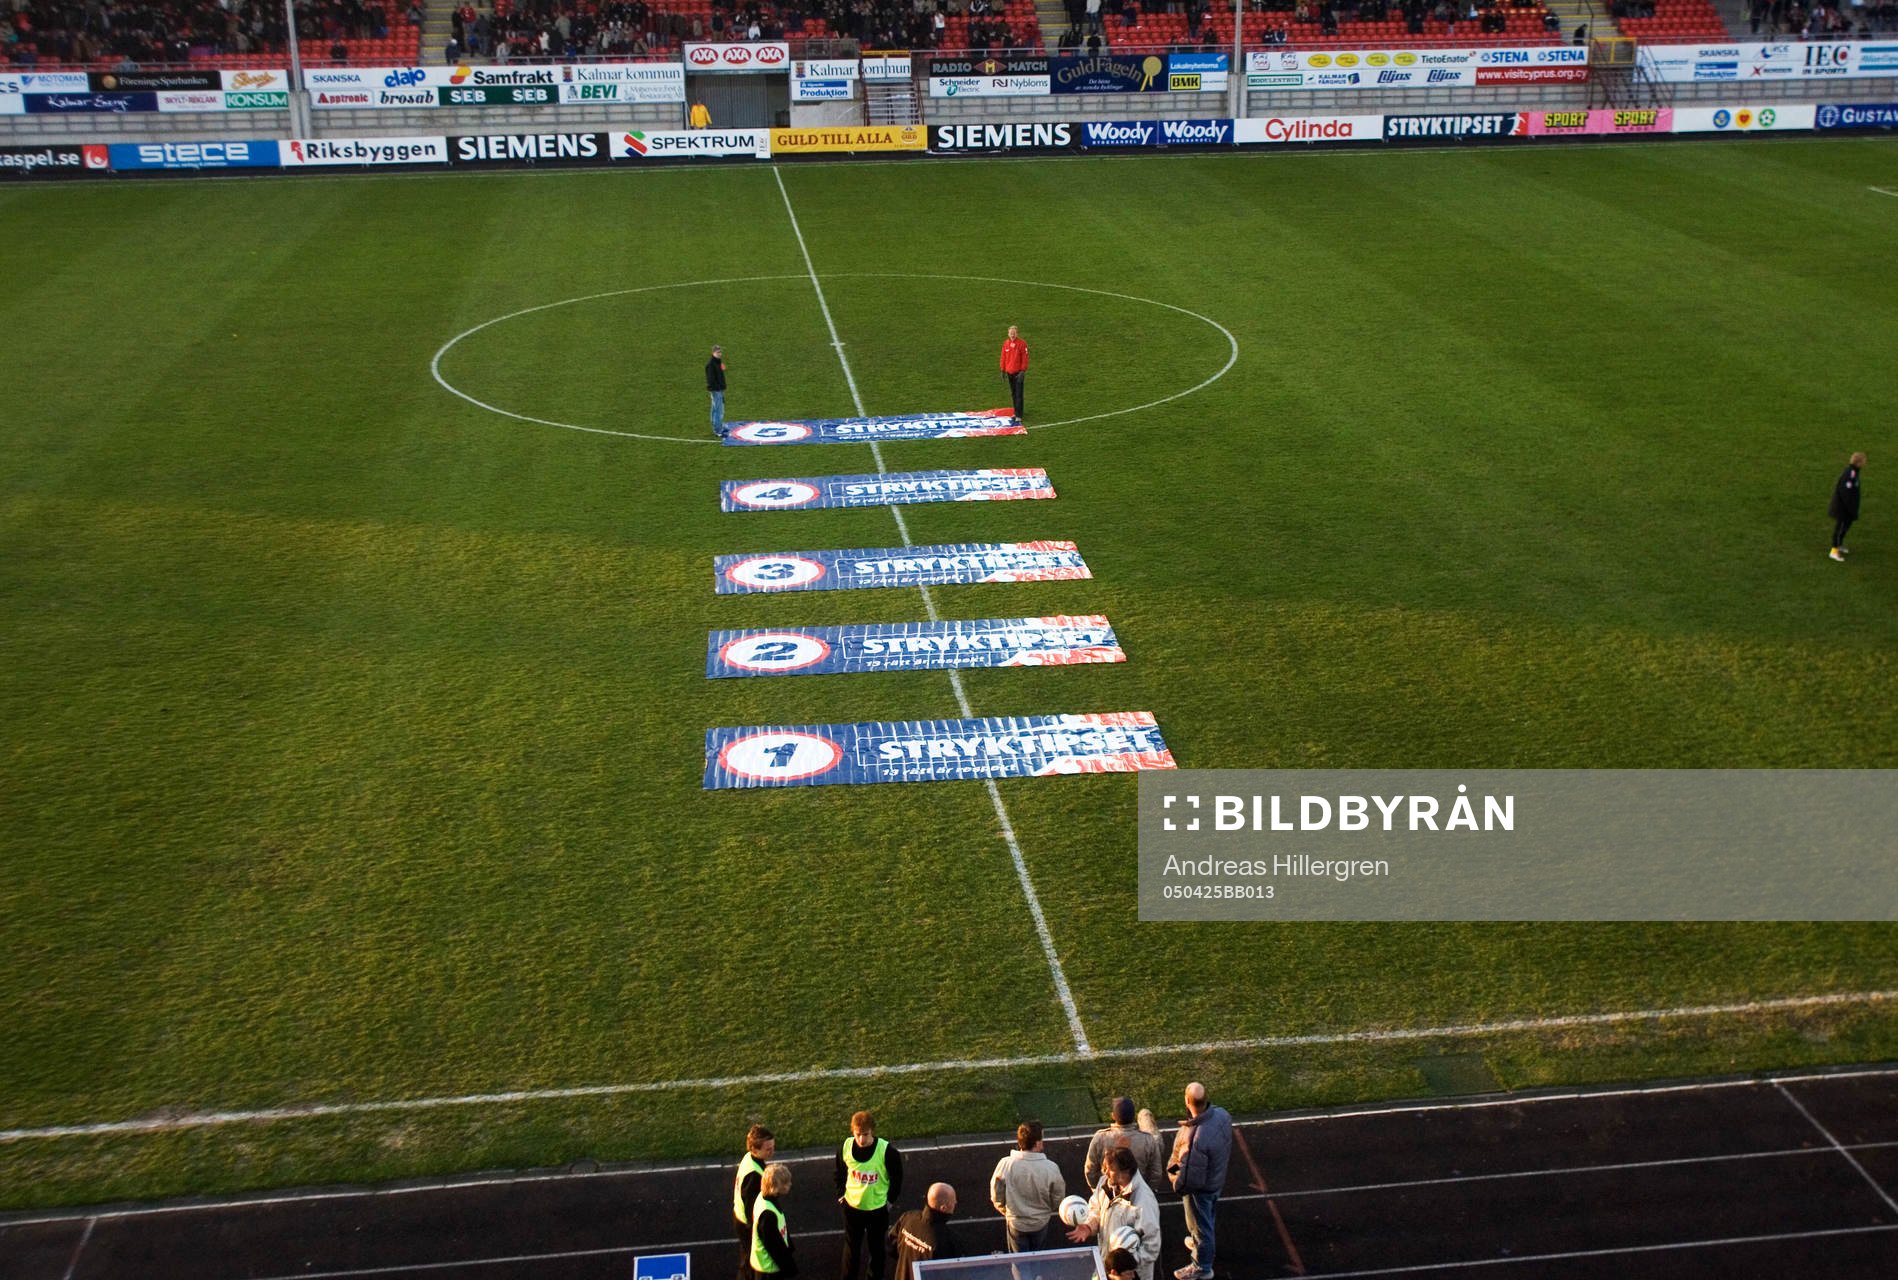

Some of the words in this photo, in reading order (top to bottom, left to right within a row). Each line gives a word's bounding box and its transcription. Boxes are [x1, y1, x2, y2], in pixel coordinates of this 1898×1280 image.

[692, 49, 717, 60] AXA
[725, 49, 749, 60] AXA
[759, 48, 783, 60] AXA
[1421, 54, 1470, 64] TietoEnator
[1491, 51, 1529, 63] STENA
[1547, 50, 1585, 62] STENA
[1699, 49, 1740, 57] SKANSKA
[1805, 45, 1850, 66] IEC
[577, 68, 623, 80] Kalmar
[626, 67, 681, 80] kommun
[809, 63, 855, 77] Kalmar
[862, 63, 911, 75] ommun
[932, 62, 972, 73] RADIO
[1008, 61, 1048, 71] MATCH
[312, 74, 362, 83] SKANSKA
[384, 66, 426, 87] elajo
[473, 70, 554, 85] Samfrakt
[939, 78, 980, 86] Schneider
[1171, 77, 1199, 87] BMK
[1477, 69, 1588, 81] www.visitcyprus.org.cy
[1010, 78, 1048, 89] Nybloms
[380, 90, 434, 105] brosab
[450, 89, 487, 103] SEB
[512, 88, 548, 102] SEB
[580, 84, 618, 99] BEVI
[800, 89, 848, 98] Produktion
[226, 93, 288, 107] KONSUM
[1387, 115, 1504, 136] STRYKTIPSET
[1544, 112, 1589, 127] SPORT
[1614, 111, 1658, 126] SPORT
[937, 123, 1072, 149] SIEMENS
[1087, 121, 1154, 145] Woody
[1163, 120, 1229, 144] Woody
[1265, 118, 1353, 141] Cylinda
[651, 135, 754, 150] SPEKTRUM
[777, 134, 819, 146] GULD
[820, 133, 853, 145] TILL
[856, 132, 893, 145] ALLA
[139, 142, 249, 163] stece
[306, 141, 436, 162] Riksbyggen
[457, 133, 598, 161] SIEMENS
[754, 425, 787, 438] 5
[755, 486, 793, 501] 4
[845, 477, 1045, 496] STRYKTIPSET
[855, 552, 1074, 575] STRYKTIPSET
[754, 562, 797, 581] 3
[862, 629, 1106, 654] STRYKTIPSET
[747, 642, 800, 662] 2
[878, 730, 1152, 761] STRYKTIPSET
[763, 742, 799, 767] 1
[882, 767, 900, 776] 13
[957, 764, 1018, 774] respekt
